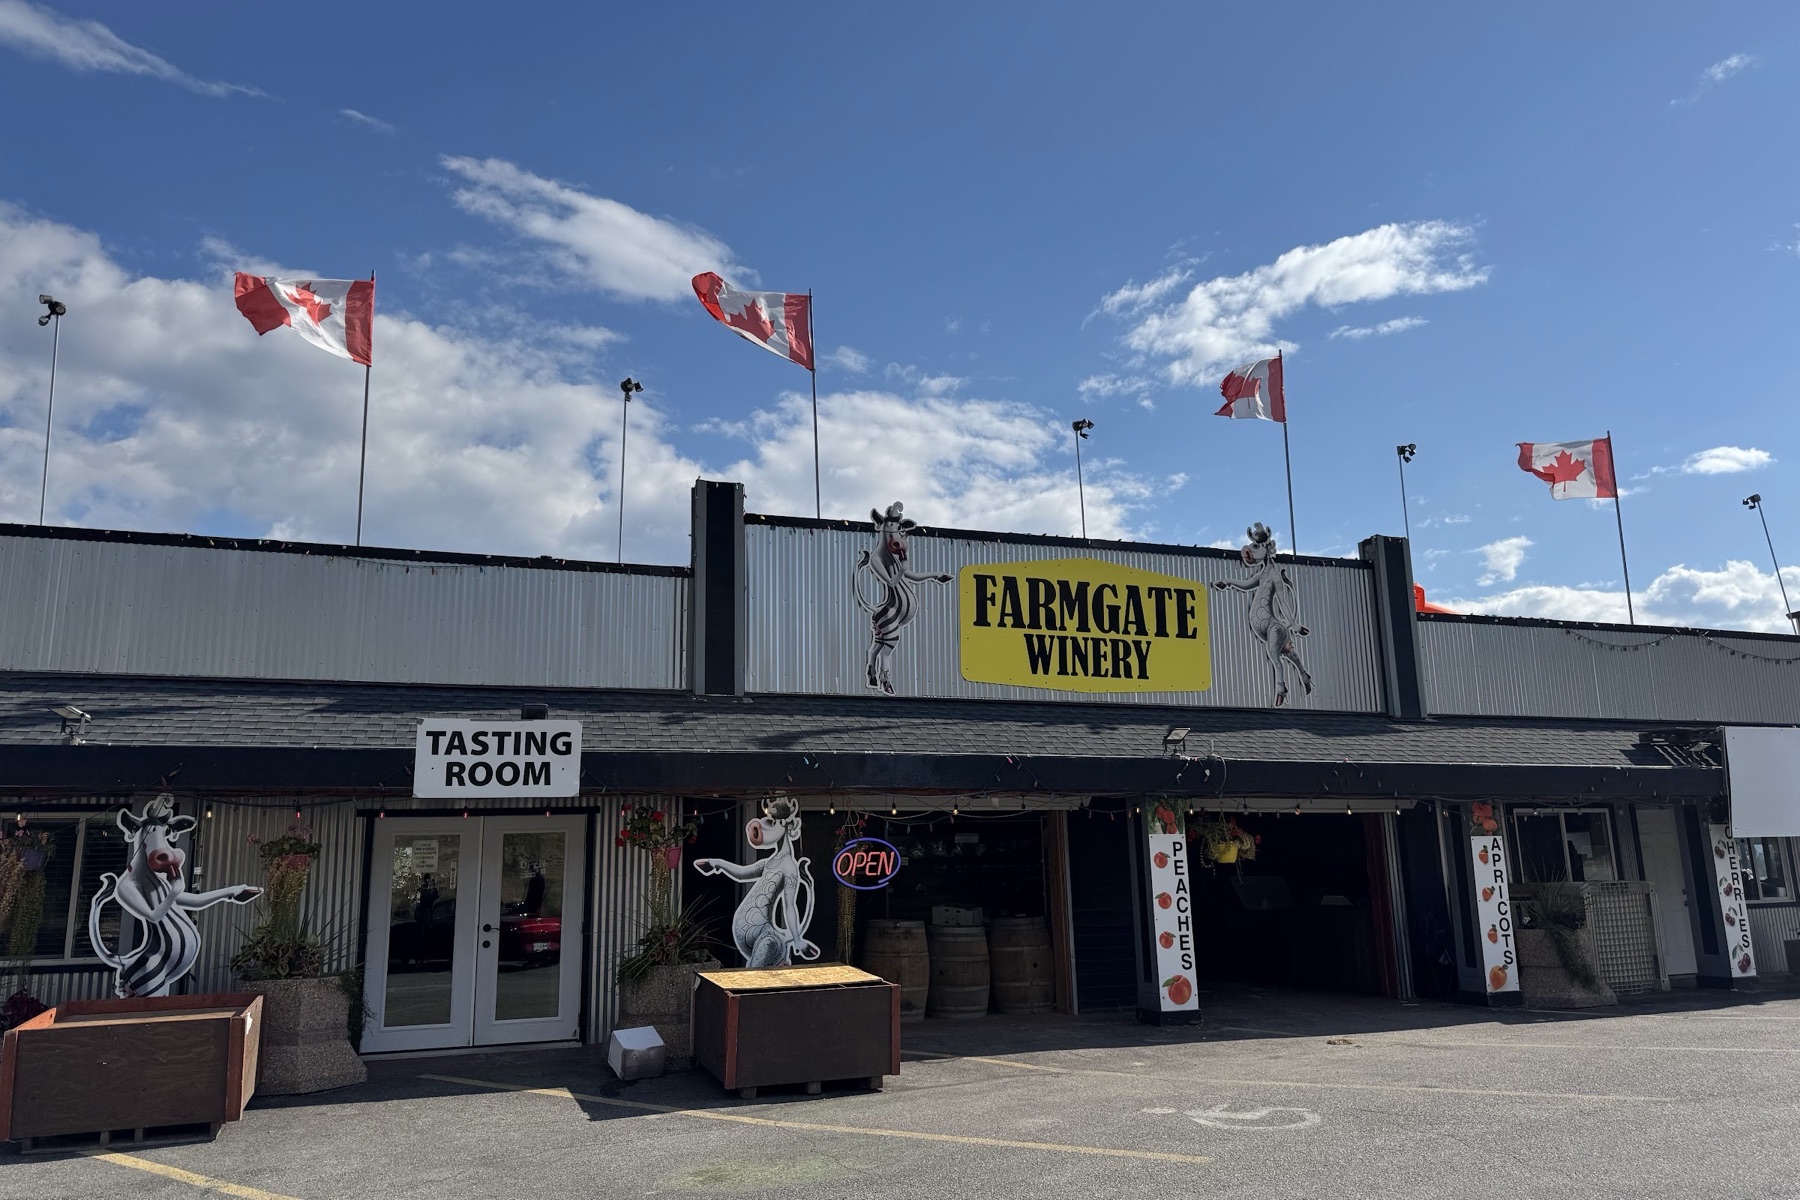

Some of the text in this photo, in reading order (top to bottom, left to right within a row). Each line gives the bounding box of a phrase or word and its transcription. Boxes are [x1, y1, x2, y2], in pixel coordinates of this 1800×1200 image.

[973, 574, 1198, 639] FARMGATE
[1024, 634, 1151, 679] WINERY
[426, 730, 573, 756] TASTING
[445, 761, 551, 786] ROOM
[837, 851, 895, 876] OPEN
[1172, 841, 1193, 970] PEACHES
[1491, 837, 1514, 965] APRICOTS
